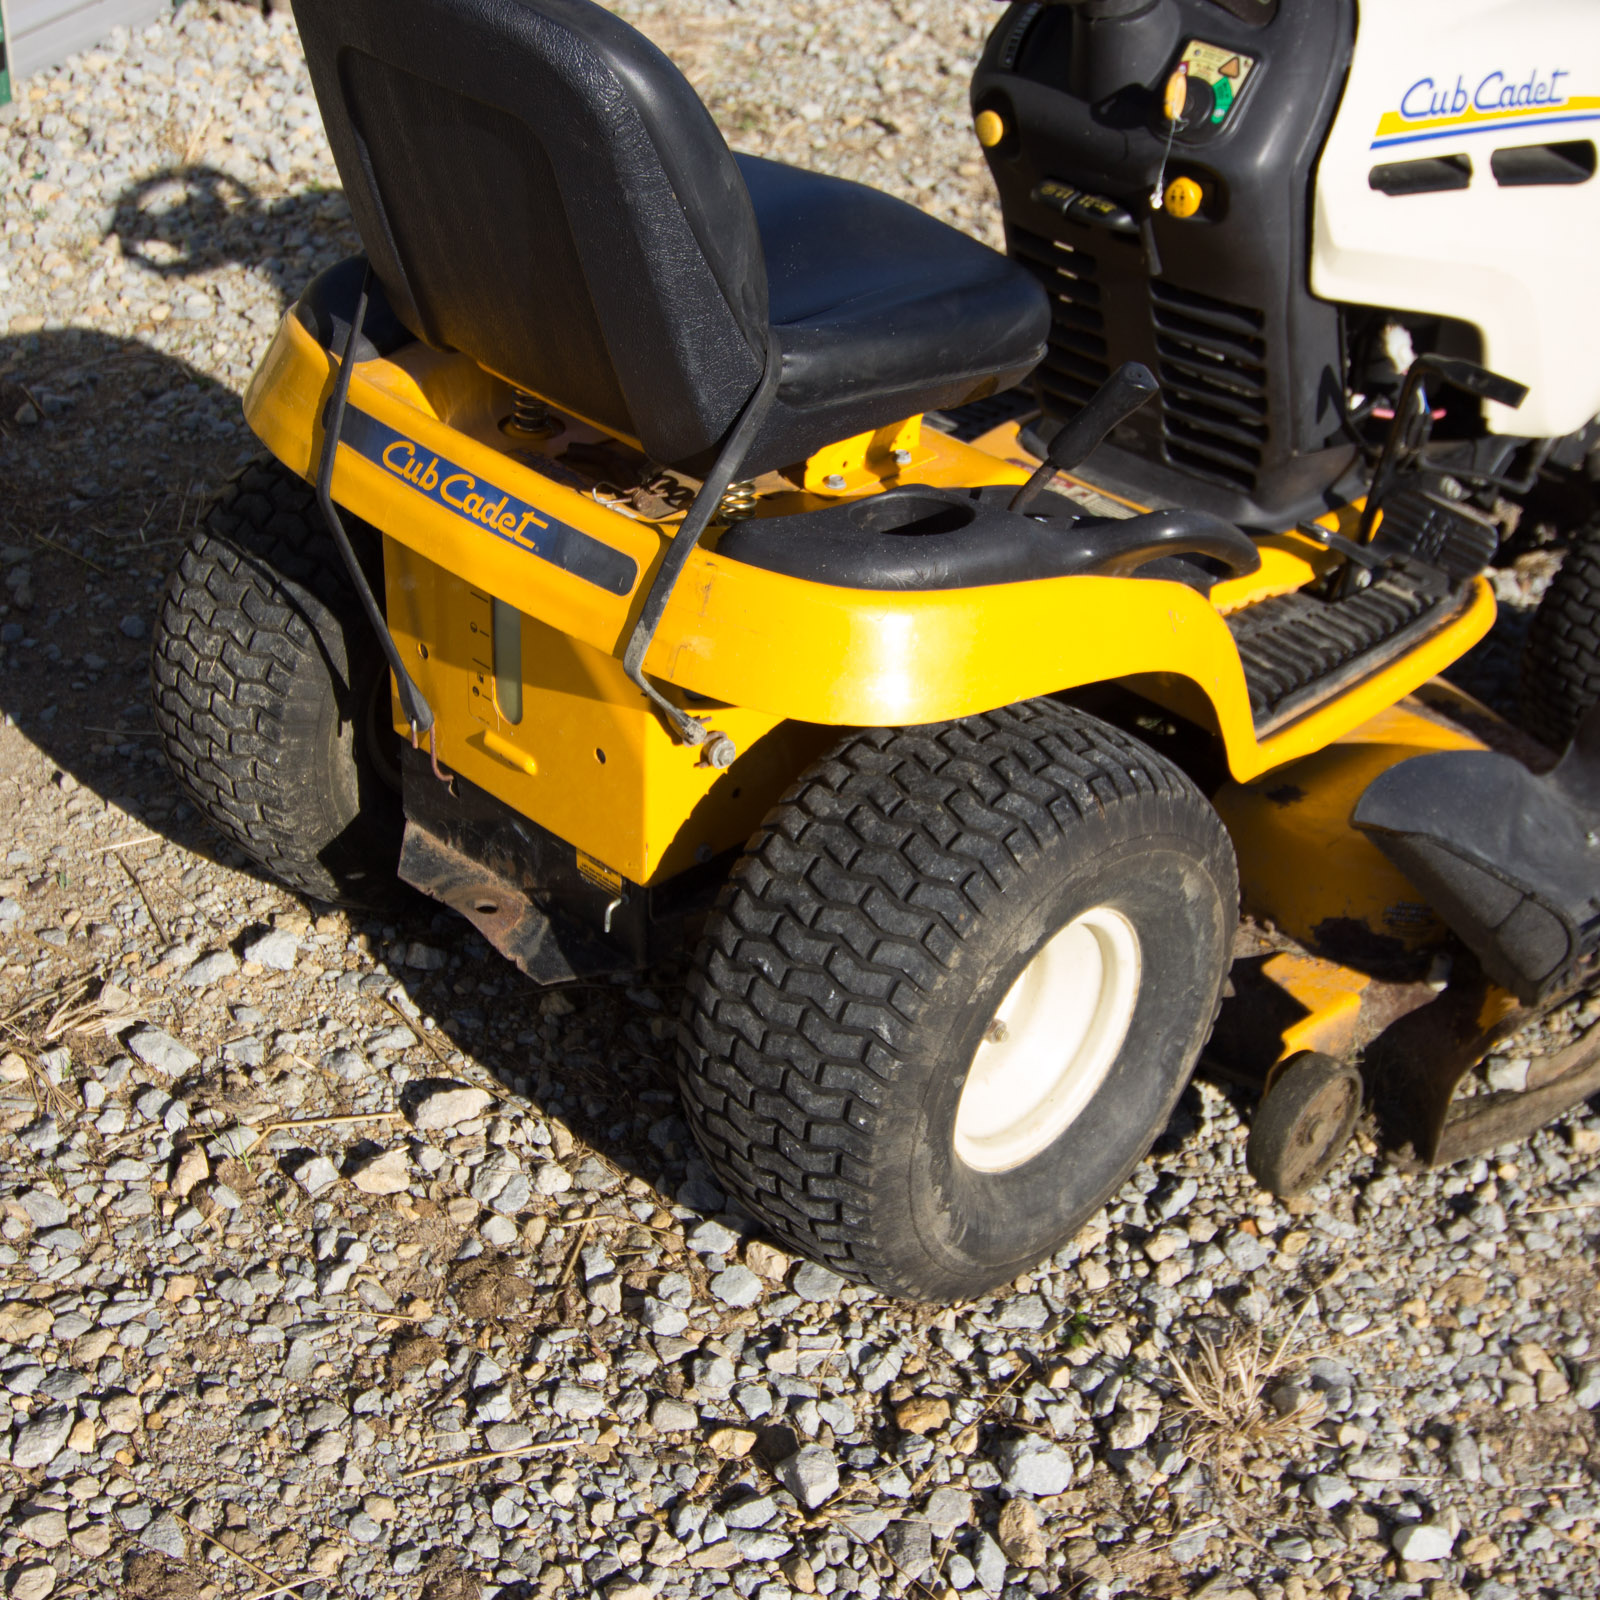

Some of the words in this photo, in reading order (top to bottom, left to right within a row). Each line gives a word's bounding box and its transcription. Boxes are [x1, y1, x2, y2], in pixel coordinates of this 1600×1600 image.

[1400, 75, 1468, 118] Cub
[1474, 69, 1569, 110] Cadet
[382, 441, 439, 490] Cub
[439, 473, 548, 550] Cadet
